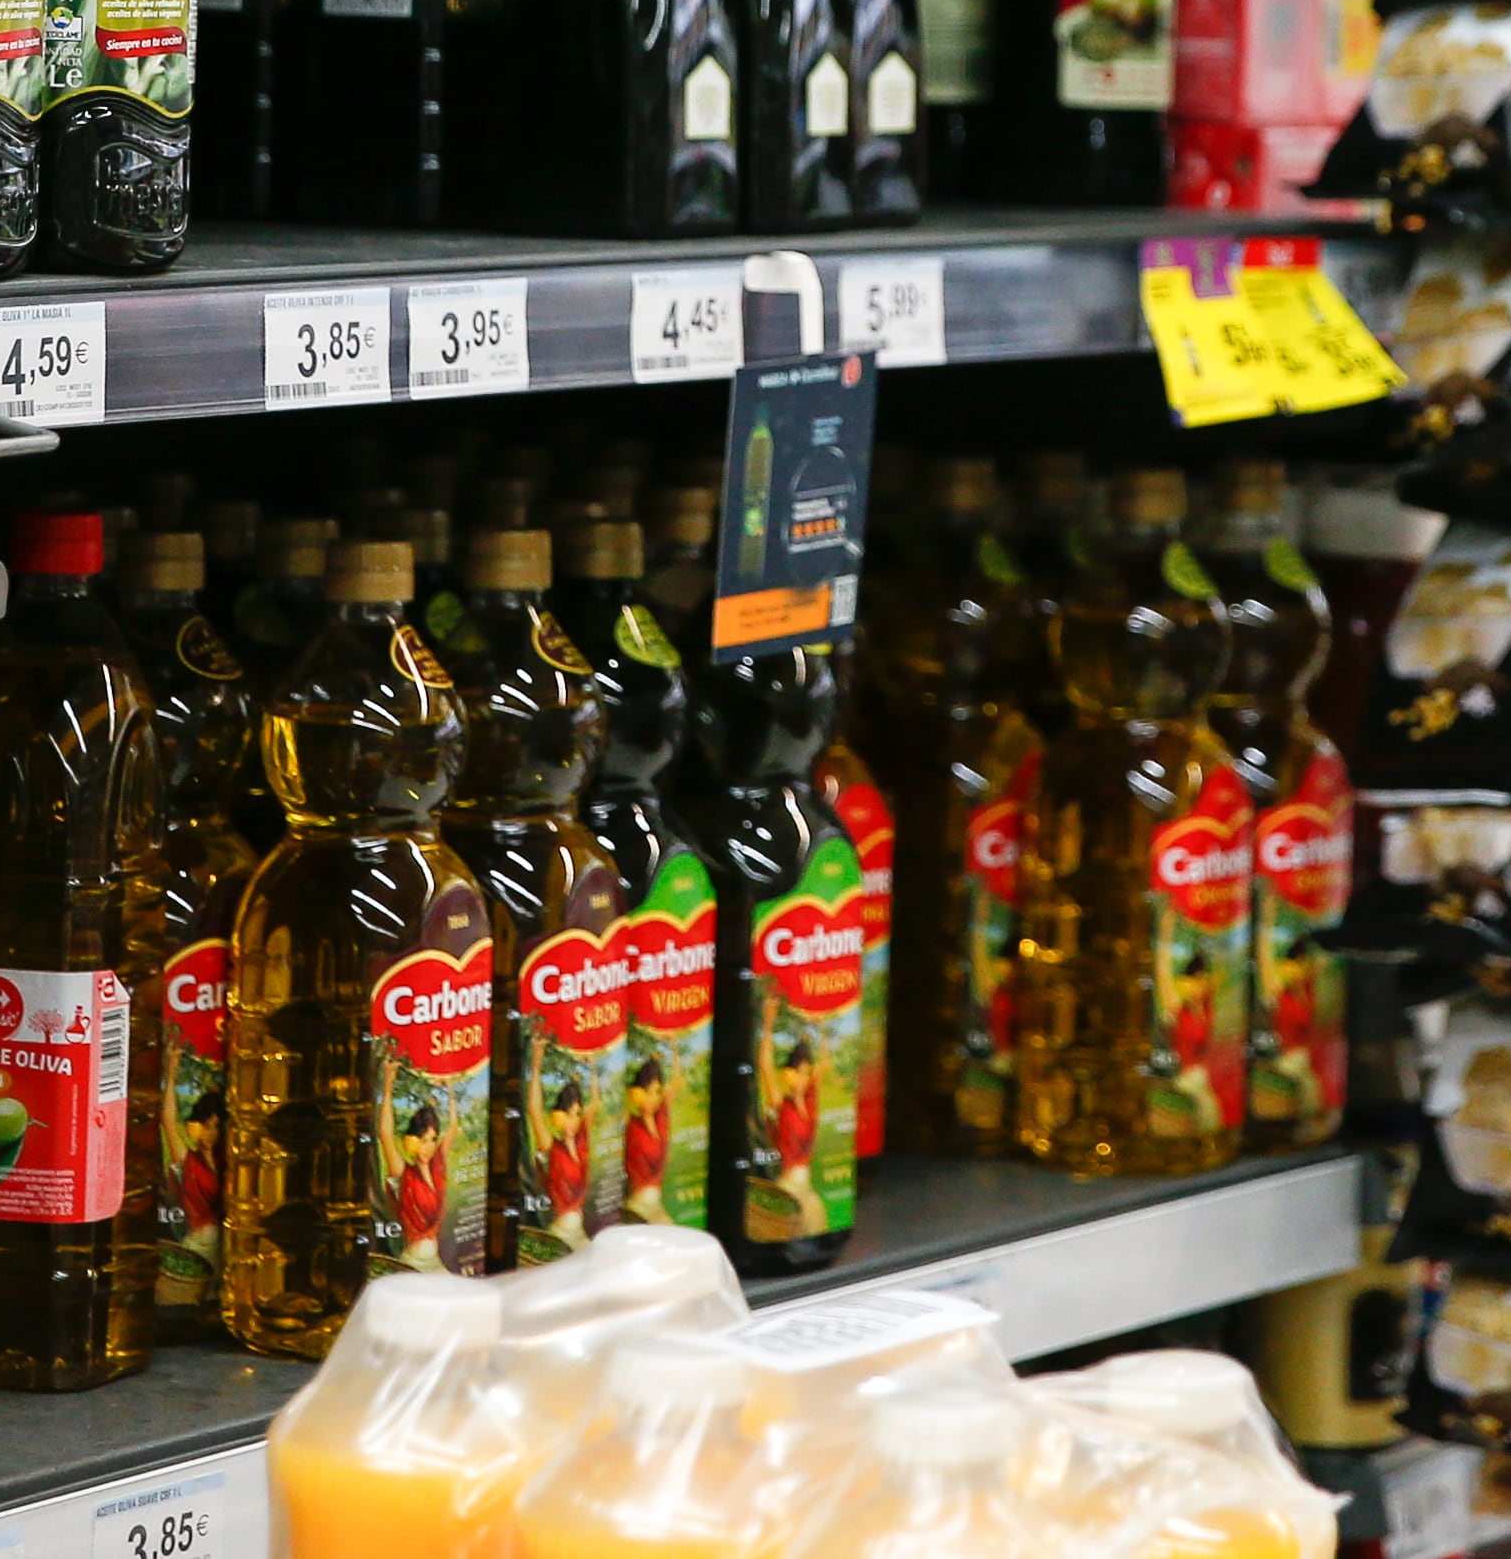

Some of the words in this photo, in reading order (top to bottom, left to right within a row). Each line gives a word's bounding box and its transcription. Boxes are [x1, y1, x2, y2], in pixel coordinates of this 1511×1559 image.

[106, 39, 142, 52] Siempre
[142, 39, 152, 48] en
[152, 37, 161, 47] tu
[2, 309, 21, 323] OLIVA
[32, 308, 41, 320] LA
[661, 296, 729, 350] 4,45€
[297, 322, 377, 379] 3,85€
[441, 309, 515, 365] 3,95€
[1, 335, 90, 396] 4,59€
[572, 1000, 621, 1033] SABOR
[430, 1025, 484, 1058] SABOR
[15, 1050, 74, 1076] OLIVA
